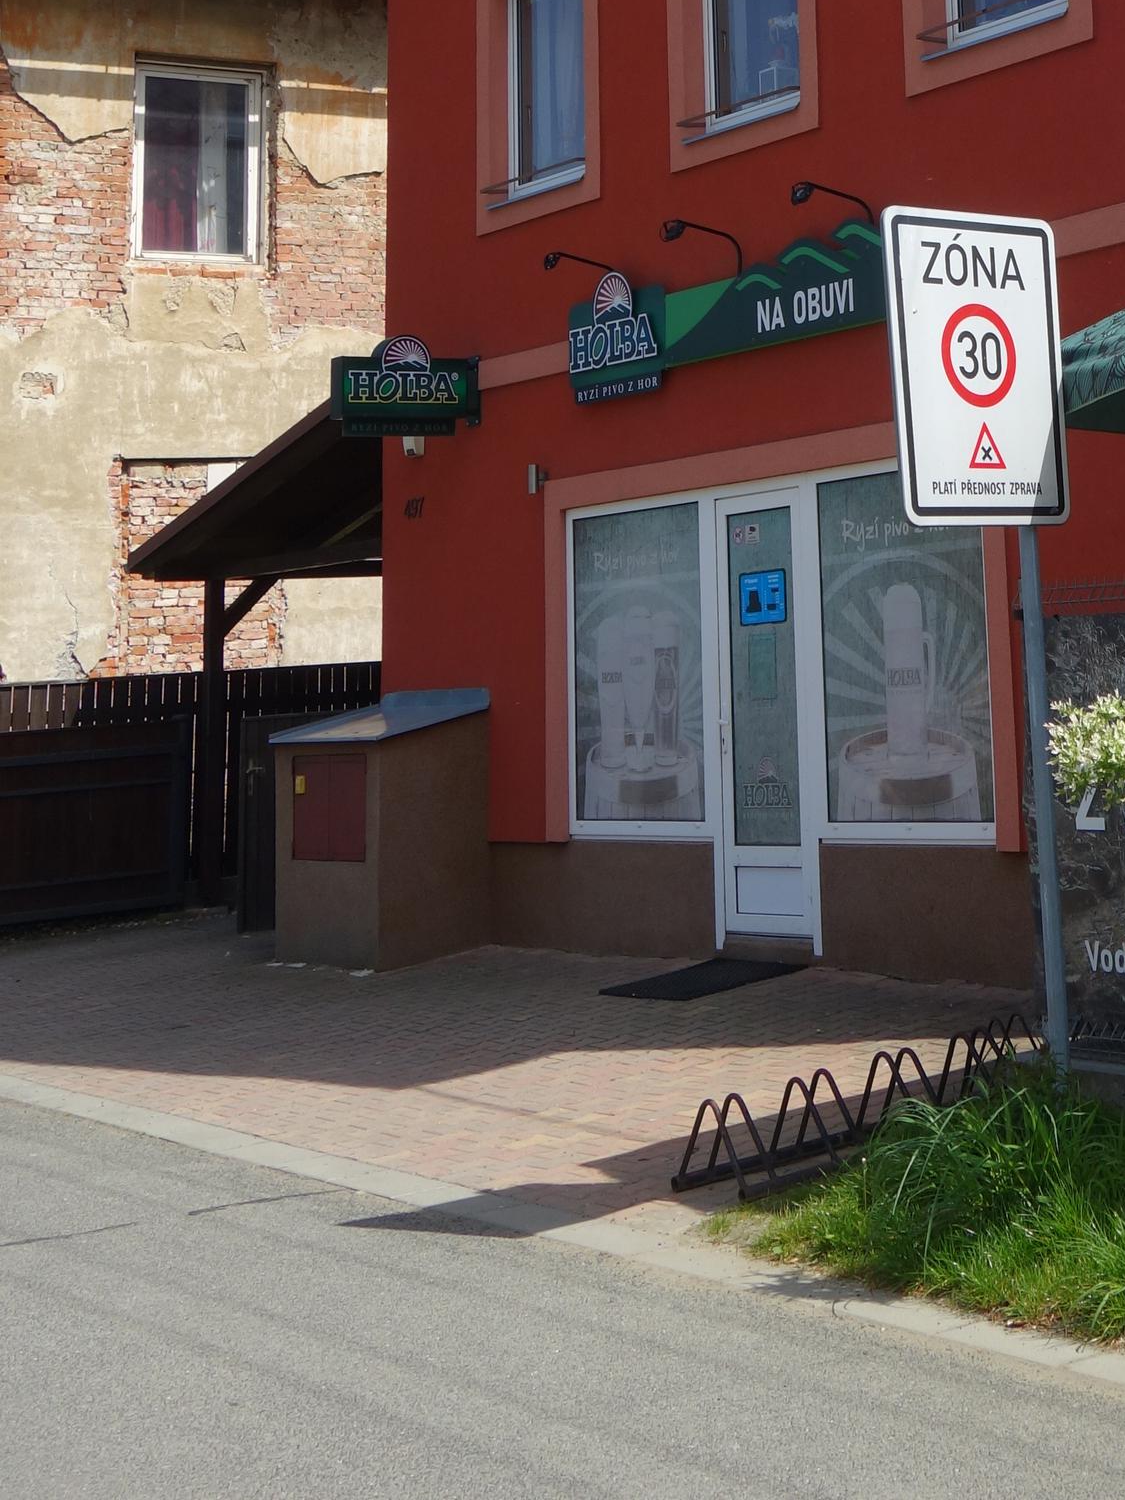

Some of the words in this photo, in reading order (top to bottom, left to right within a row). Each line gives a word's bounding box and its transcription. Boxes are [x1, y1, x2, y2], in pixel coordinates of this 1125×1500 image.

[920, 233, 1026, 291] ZÓNA
[756, 296, 786, 334] NA
[793, 278, 855, 324] OBUVI
[569, 313, 658, 373] HOLBA
[957, 330, 1003, 381] 30
[348, 370, 459, 404] HOLBA
[577, 384, 599, 402] RYZÍ
[602, 383, 624, 397] PIVO
[627, 381, 634, 392] Z
[637, 376, 658, 390] HOR
[932, 479, 957, 495] PLATÍ
[961, 479, 1006, 495] PŘEDNOST
[1009, 482, 1043, 496] ZPRAVA
[403, 496, 425, 519] 497
[841, 517, 879, 553] Ryzí
[884, 516, 909, 547] pivo
[742, 783, 793, 808] HOLBA
